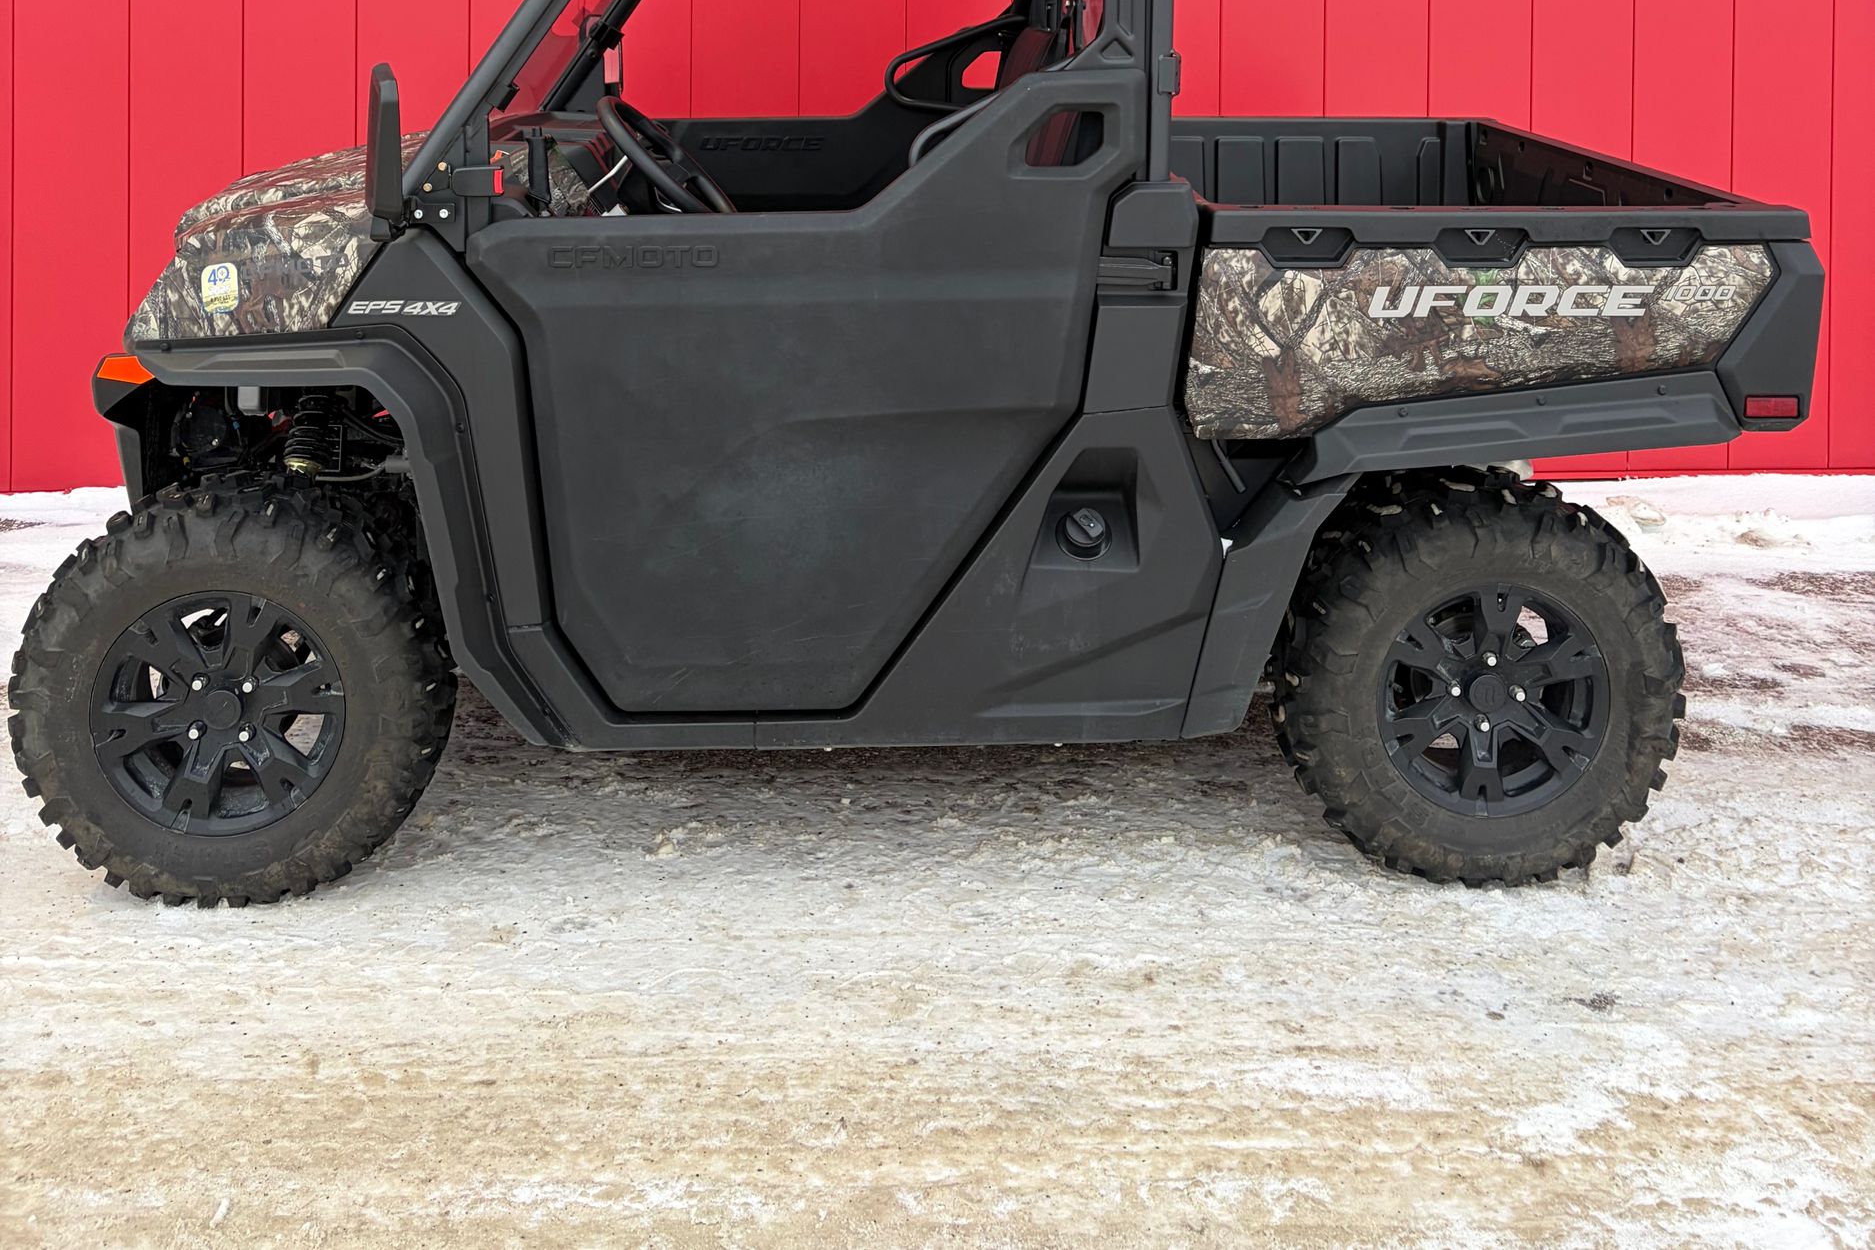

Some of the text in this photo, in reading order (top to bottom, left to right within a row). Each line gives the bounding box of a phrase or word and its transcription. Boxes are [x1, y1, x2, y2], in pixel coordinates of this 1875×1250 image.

[700, 135, 824, 151] UFORCE
[548, 245, 720, 269] CFMOTO
[347, 300, 459, 316] EPS 4X4
[1368, 285, 1737, 318] UFORCE 1000
